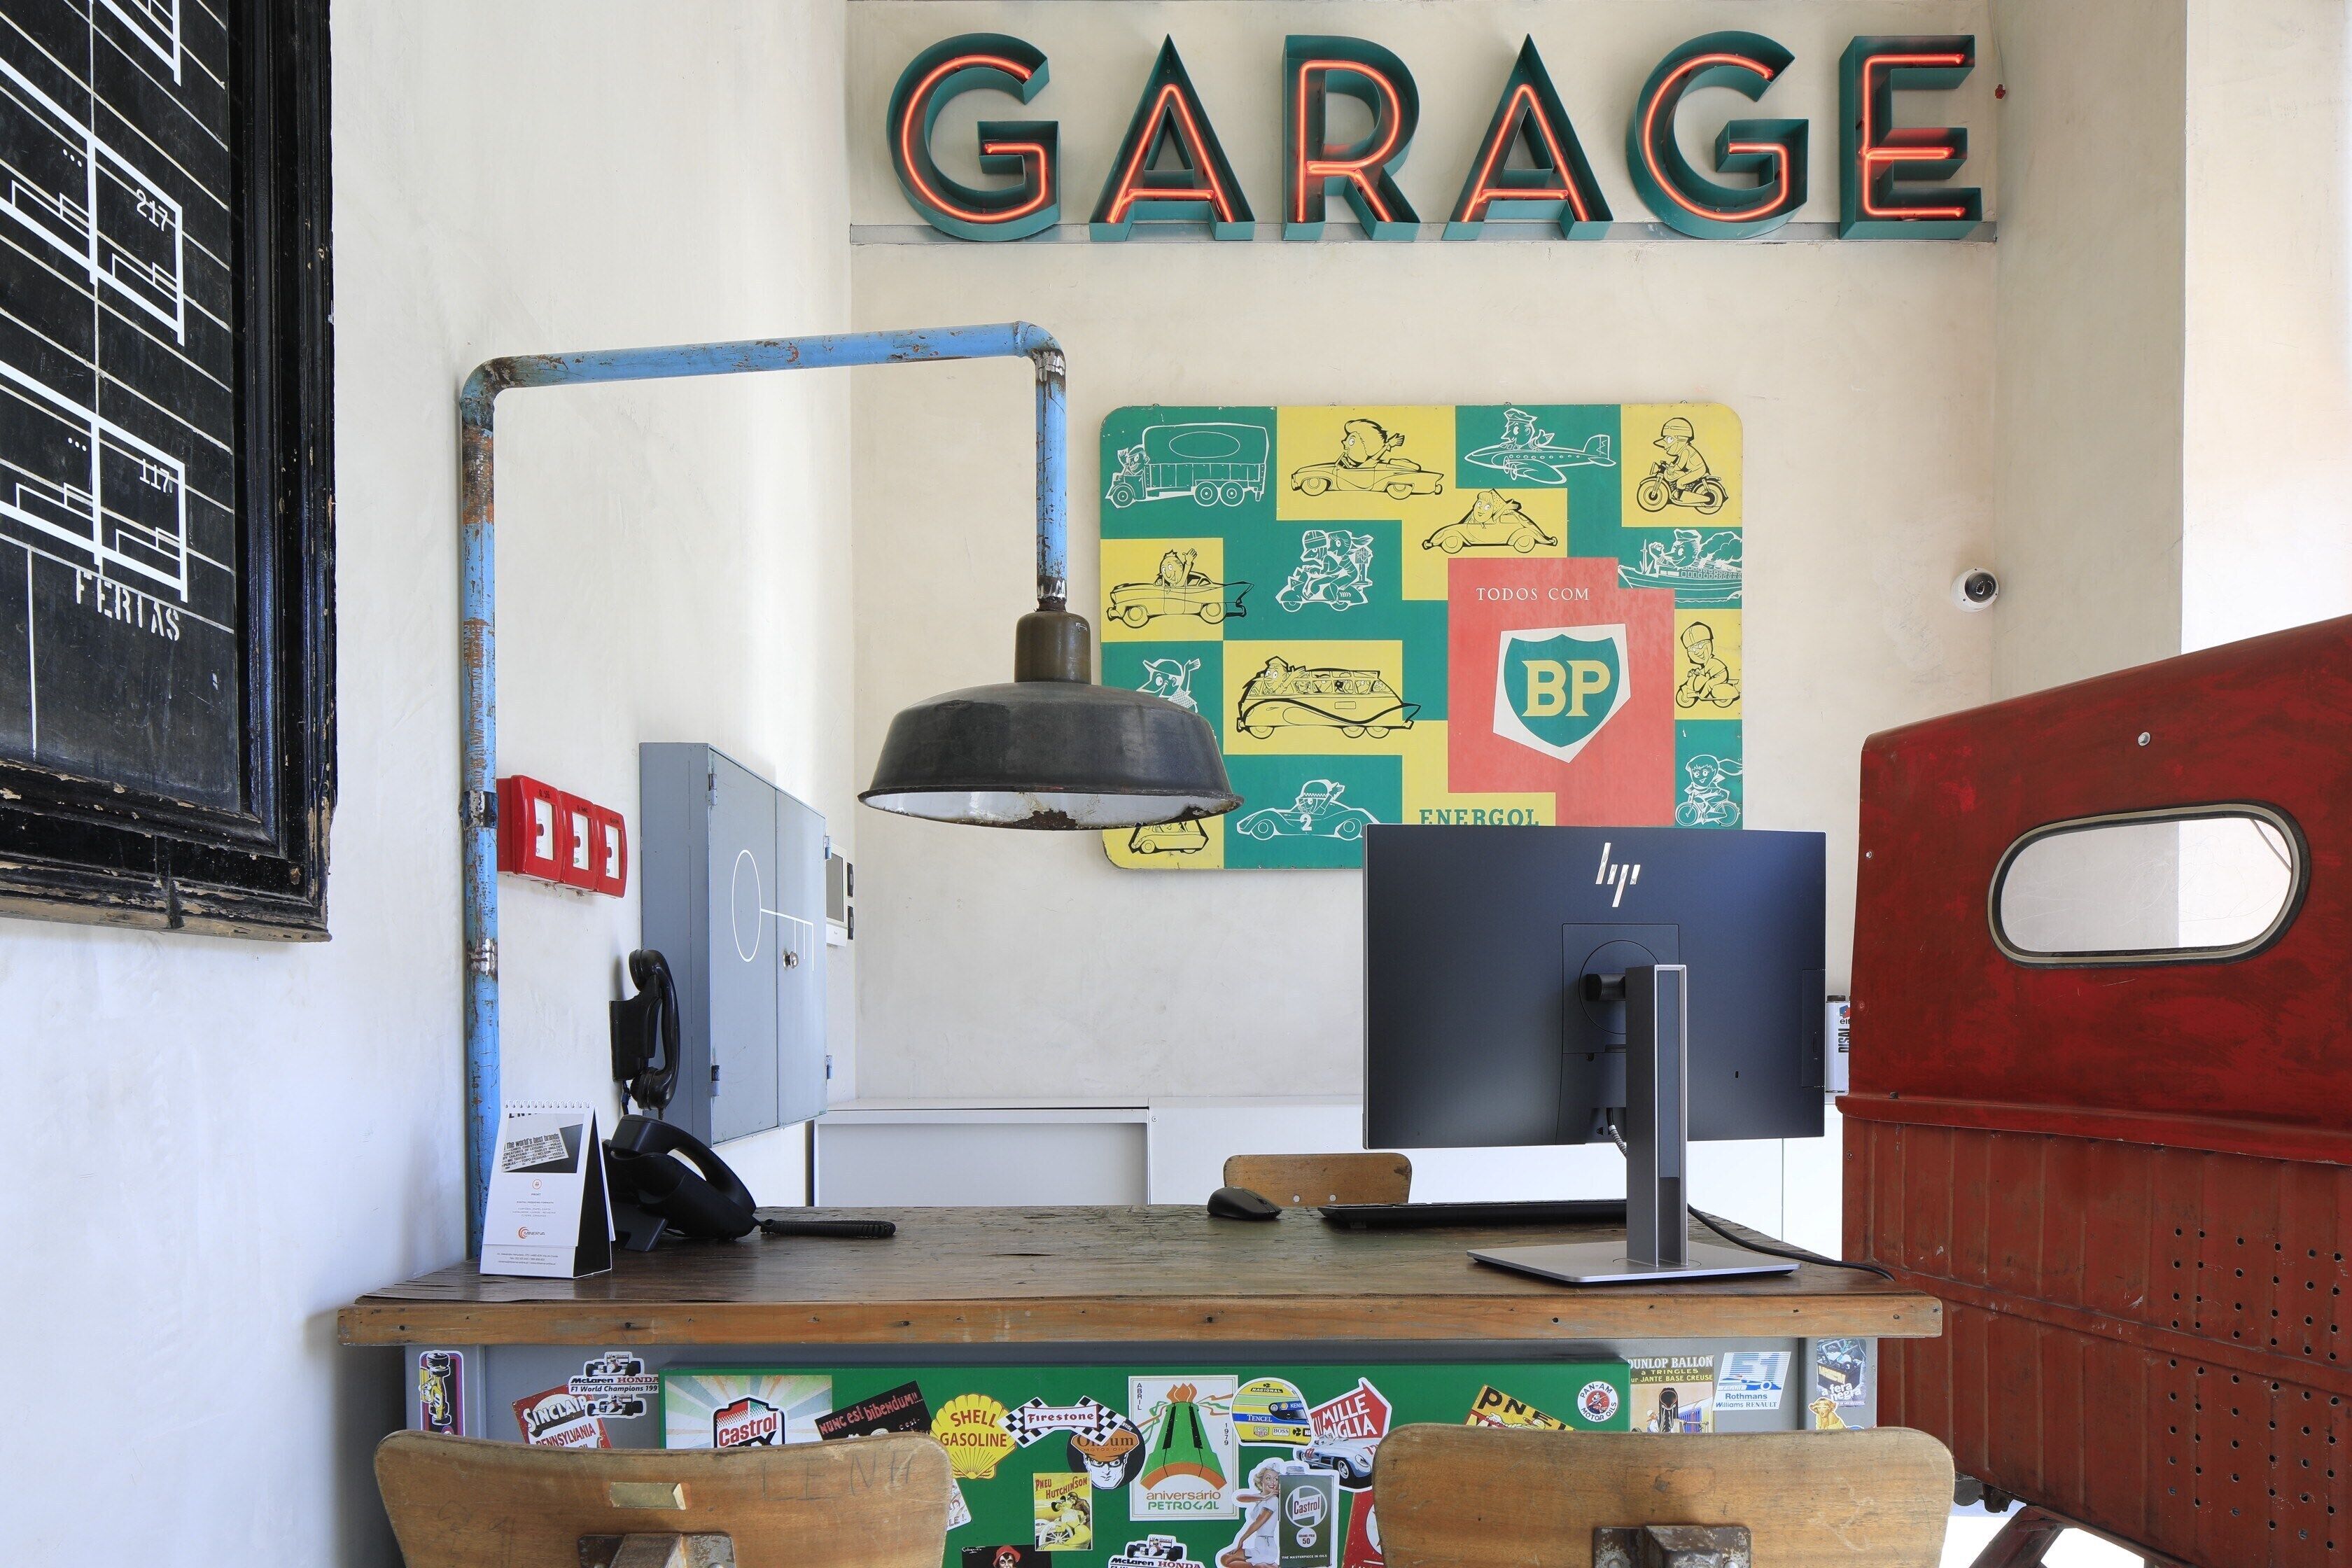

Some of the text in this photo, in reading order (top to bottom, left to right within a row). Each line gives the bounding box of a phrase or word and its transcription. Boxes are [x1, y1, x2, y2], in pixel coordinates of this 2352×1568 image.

[885, 31, 1982, 241] GARAGE
[136, 188, 169, 232] 217
[139, 457, 172, 493] 117
[1476, 587, 1590, 601] TODOS COM
[1520, 659, 1611, 718] BP
[1299, 813, 1313, 832] 2
[1418, 808, 1540, 826] ENERGOL
[1628, 1356, 1714, 1370] DUNLOP BALLON
[603, 1385, 644, 1393] Champions
[1580, 1383, 1613, 1399] PAN-AM
[1829, 1382, 1853, 1394] fera
[1830, 1387, 1861, 1401] negra
[950, 1409, 997, 1429] SHELL
[1026, 1412, 1095, 1424] Firestone
[1247, 1414, 1273, 1422] TENCEL
[1322, 1393, 1370, 1427] MILLE
[1581, 1402, 1617, 1421] MOTOR OILS
[718, 1412, 777, 1447] Castrol
[818, 1415, 847, 1435] NUNC
[1322, 1413, 1378, 1439] MIGLIA
[939, 1432, 1007, 1448] GASOLINE
[1035, 1478, 1052, 1492] PNEU
[1045, 1476, 1088, 1500] HUTCHINSON
[1146, 1490, 1222, 1501] aniversário
[1147, 1501, 1220, 1511] PETROGAL
[1294, 1496, 1320, 1515] Castrol
[1110, 1558, 1154, 1567] McLaren
